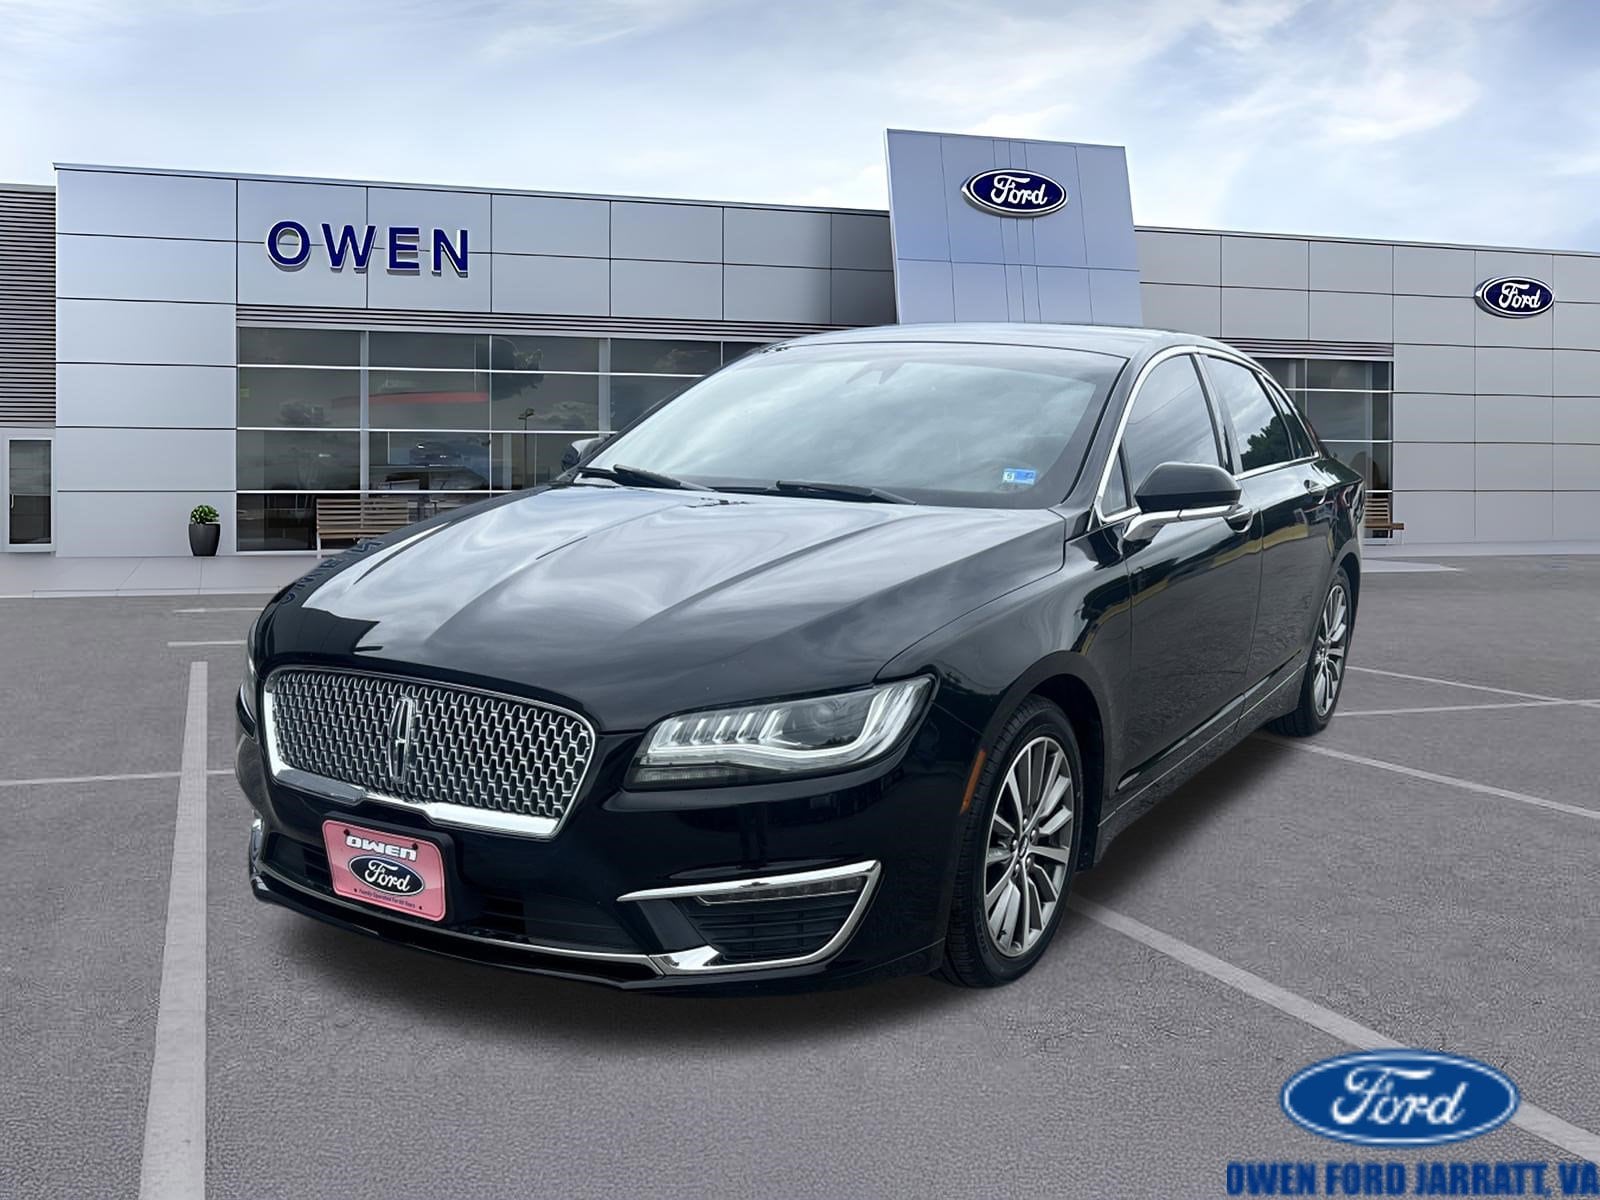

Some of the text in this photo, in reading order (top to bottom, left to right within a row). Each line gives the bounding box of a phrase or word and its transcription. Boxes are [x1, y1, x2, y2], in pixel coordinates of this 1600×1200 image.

[991, 175, 1047, 205] Ford
[266, 219, 468, 276] OWEN
[1499, 282, 1541, 308] Ford
[364, 860, 410, 892] Ford
